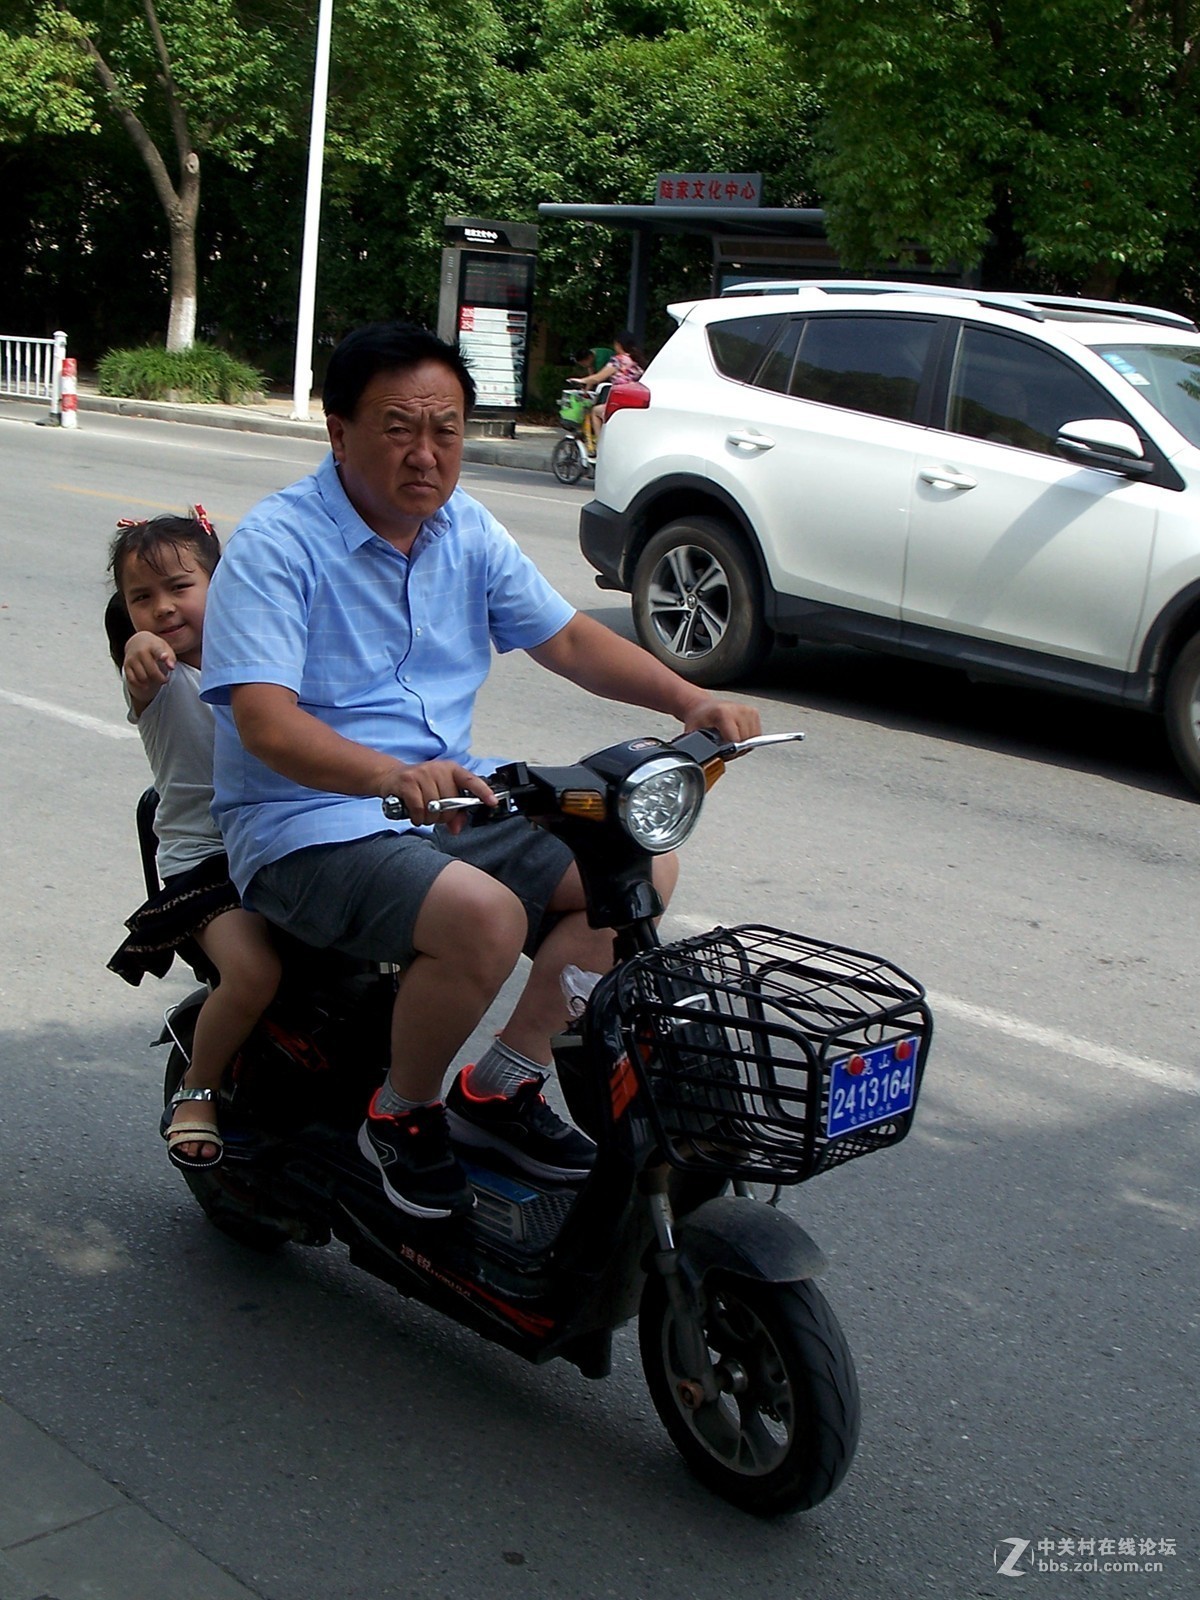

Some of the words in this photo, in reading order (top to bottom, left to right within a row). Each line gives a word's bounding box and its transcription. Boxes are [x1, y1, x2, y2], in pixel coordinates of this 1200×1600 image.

[660, 179, 756, 200] 陆家文化中心
[832, 1065, 911, 1119] 2413164
